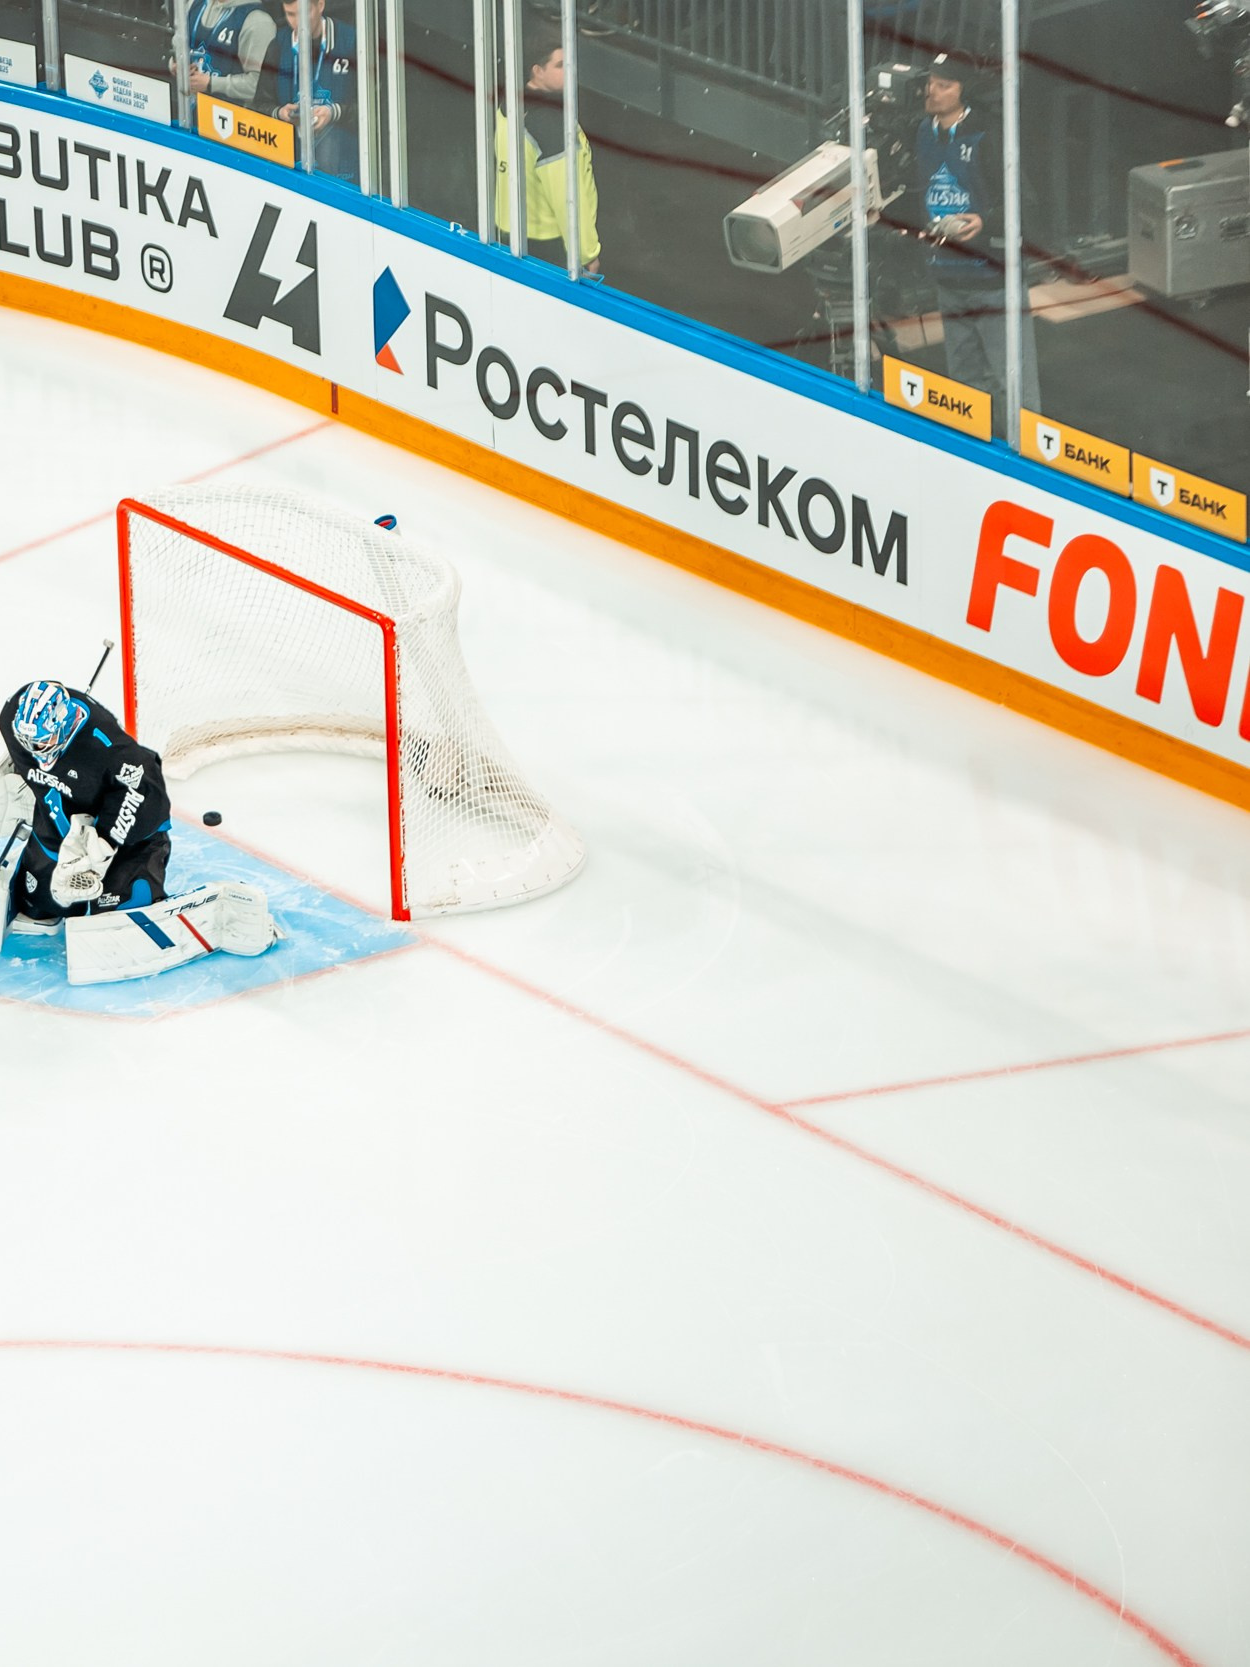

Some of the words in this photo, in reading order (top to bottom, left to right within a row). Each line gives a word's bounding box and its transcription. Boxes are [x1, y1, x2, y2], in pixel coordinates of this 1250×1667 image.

[217, 27, 234, 45] 61
[332, 58, 349, 74] 62
[237, 121, 278, 149] БАНК
[928, 388, 973, 419] БАНК
[424, 292, 908, 586] Ростелеком
[1065, 442, 1111, 473] БАНК
[1179, 488, 1227, 520] БАНК
[966, 501, 1250, 742] FON
[164, 893, 219, 915] TRUE
